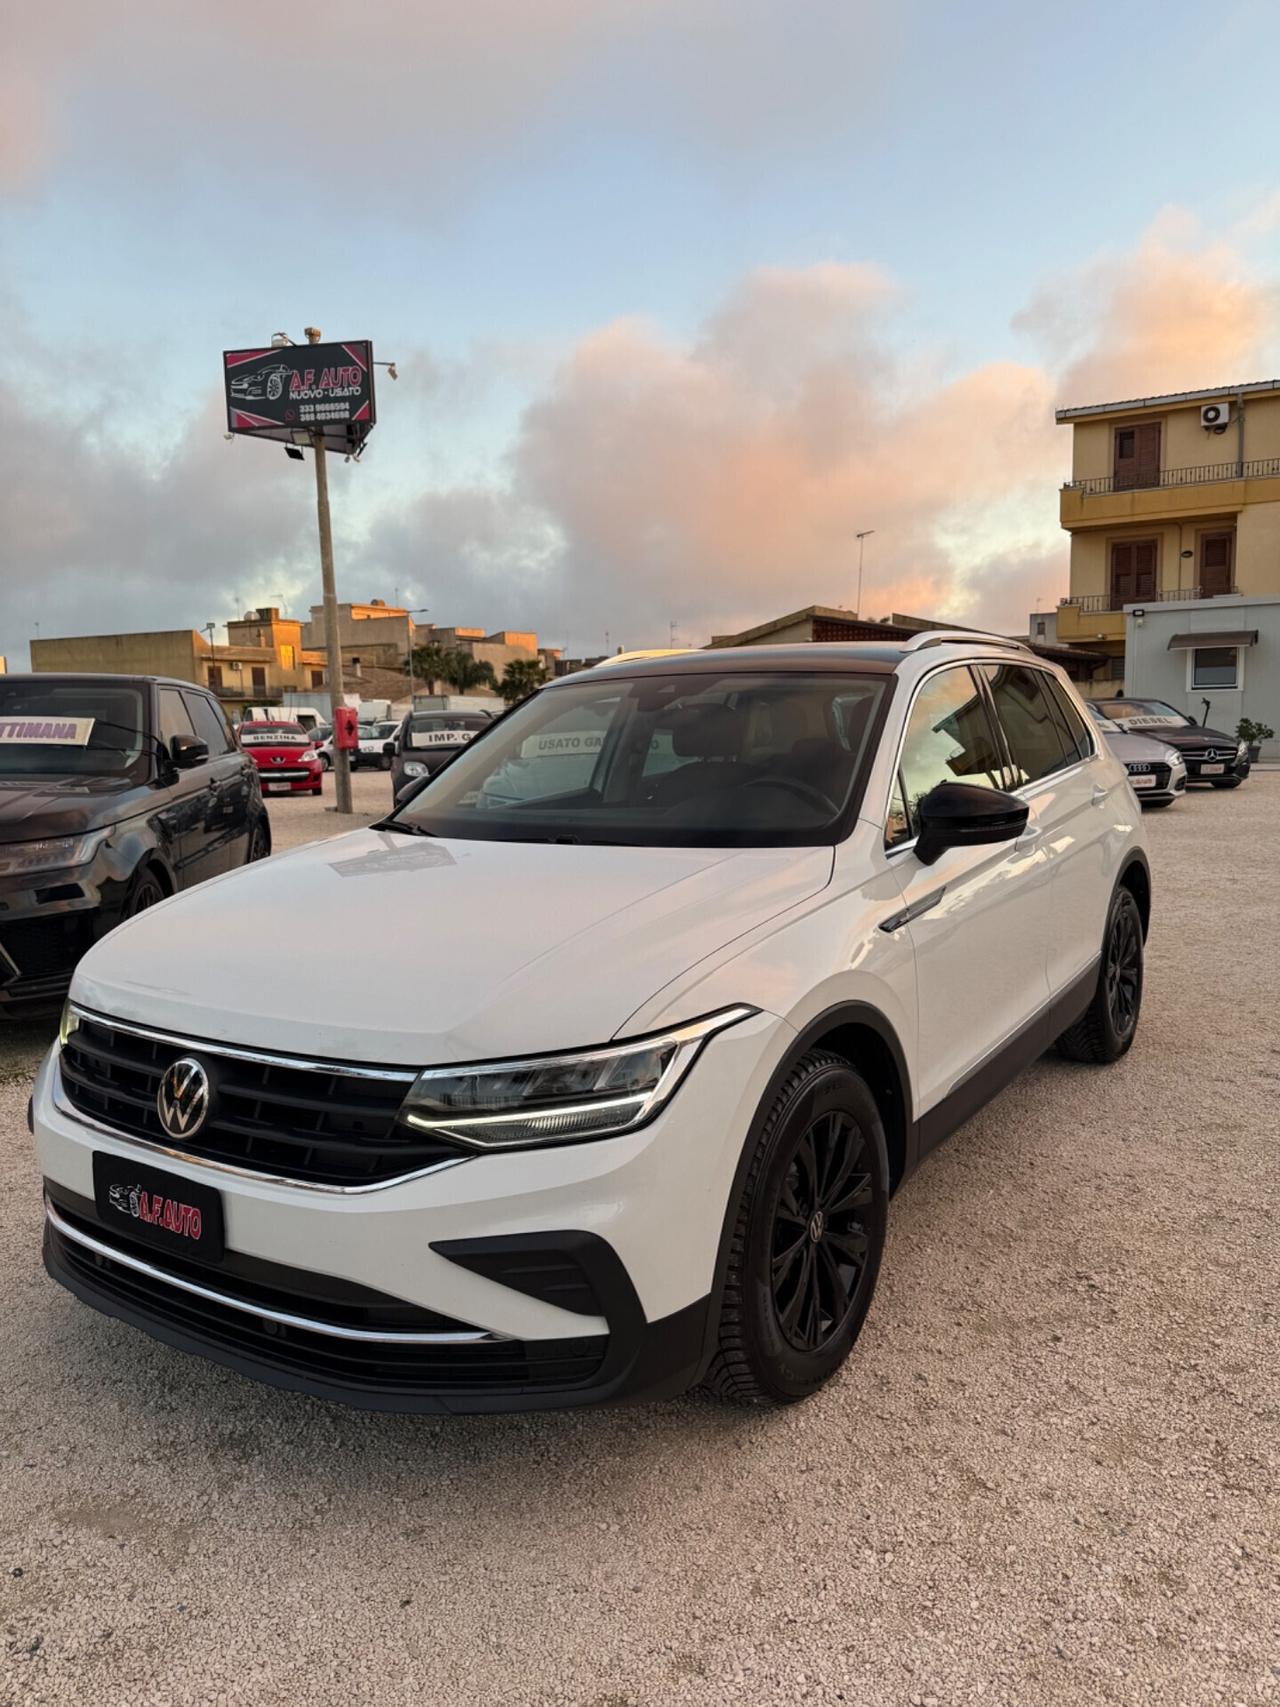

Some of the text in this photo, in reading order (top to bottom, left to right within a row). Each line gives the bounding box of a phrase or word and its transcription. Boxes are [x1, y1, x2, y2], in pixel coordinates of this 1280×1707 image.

[319, 365, 362, 388] AUTO
[289, 386, 361, 400] NUOVO USATO
[1129, 716, 1173, 725] DIESEL
[429, 733, 471, 742] IMP. G
[538, 736, 581, 750] USATO
